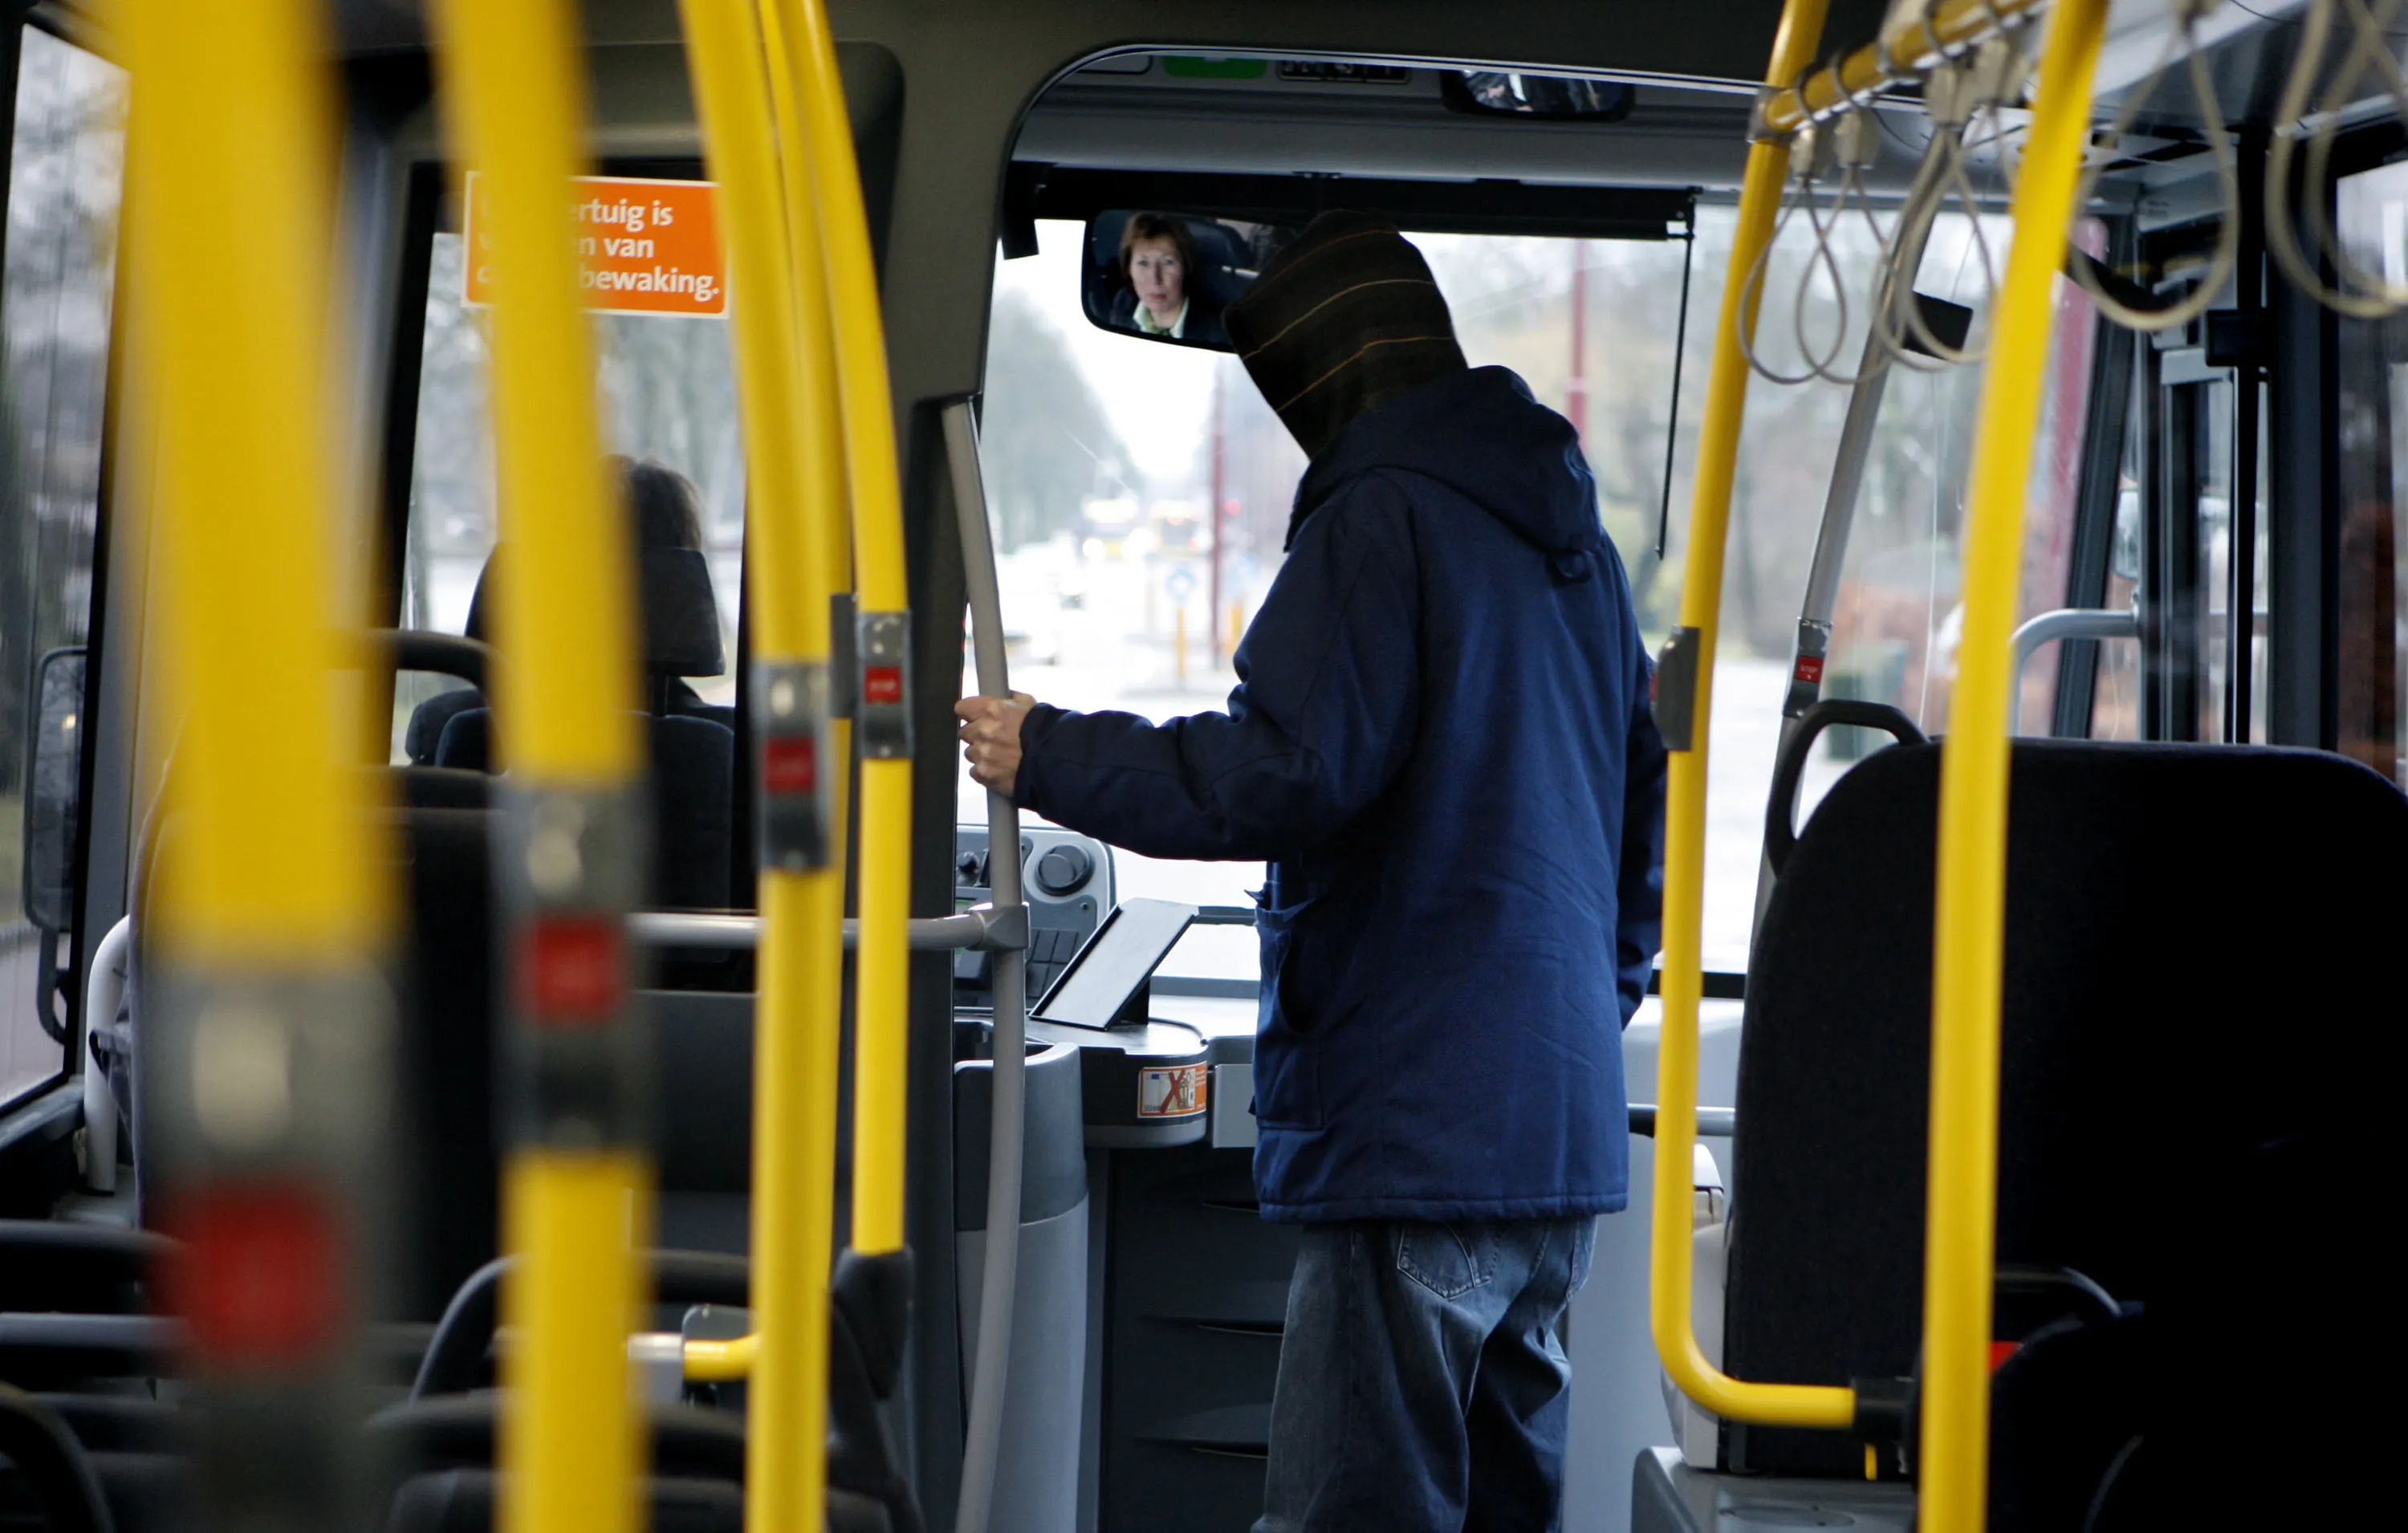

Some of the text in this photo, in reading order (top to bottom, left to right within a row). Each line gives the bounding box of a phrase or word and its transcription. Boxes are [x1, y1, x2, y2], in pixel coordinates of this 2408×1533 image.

[567, 198, 673, 232] ertuig is
[604, 238, 654, 258] van
